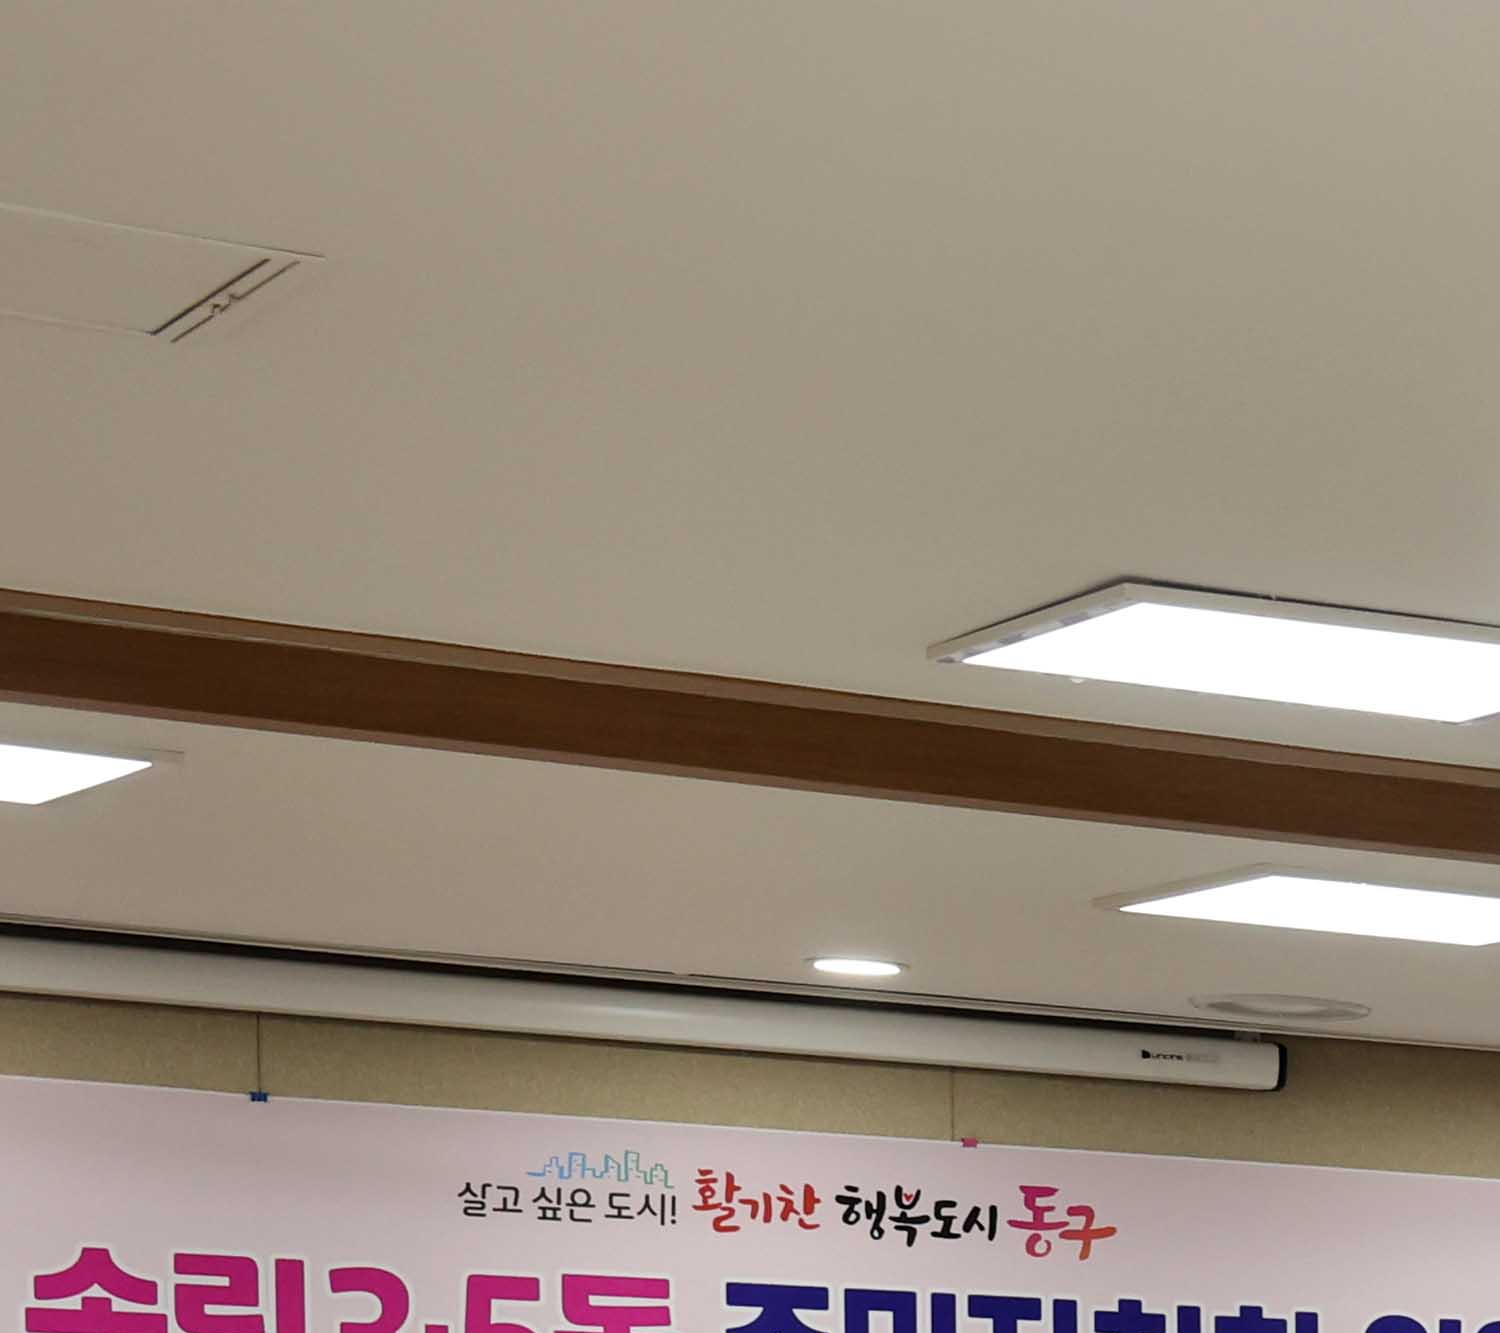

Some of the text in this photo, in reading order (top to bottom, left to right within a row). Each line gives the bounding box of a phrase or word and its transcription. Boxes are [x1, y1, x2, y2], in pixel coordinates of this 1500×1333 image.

[457, 1168, 1118, 1260] 살고 싶은 도시! 활기찬 행복도시 동구
